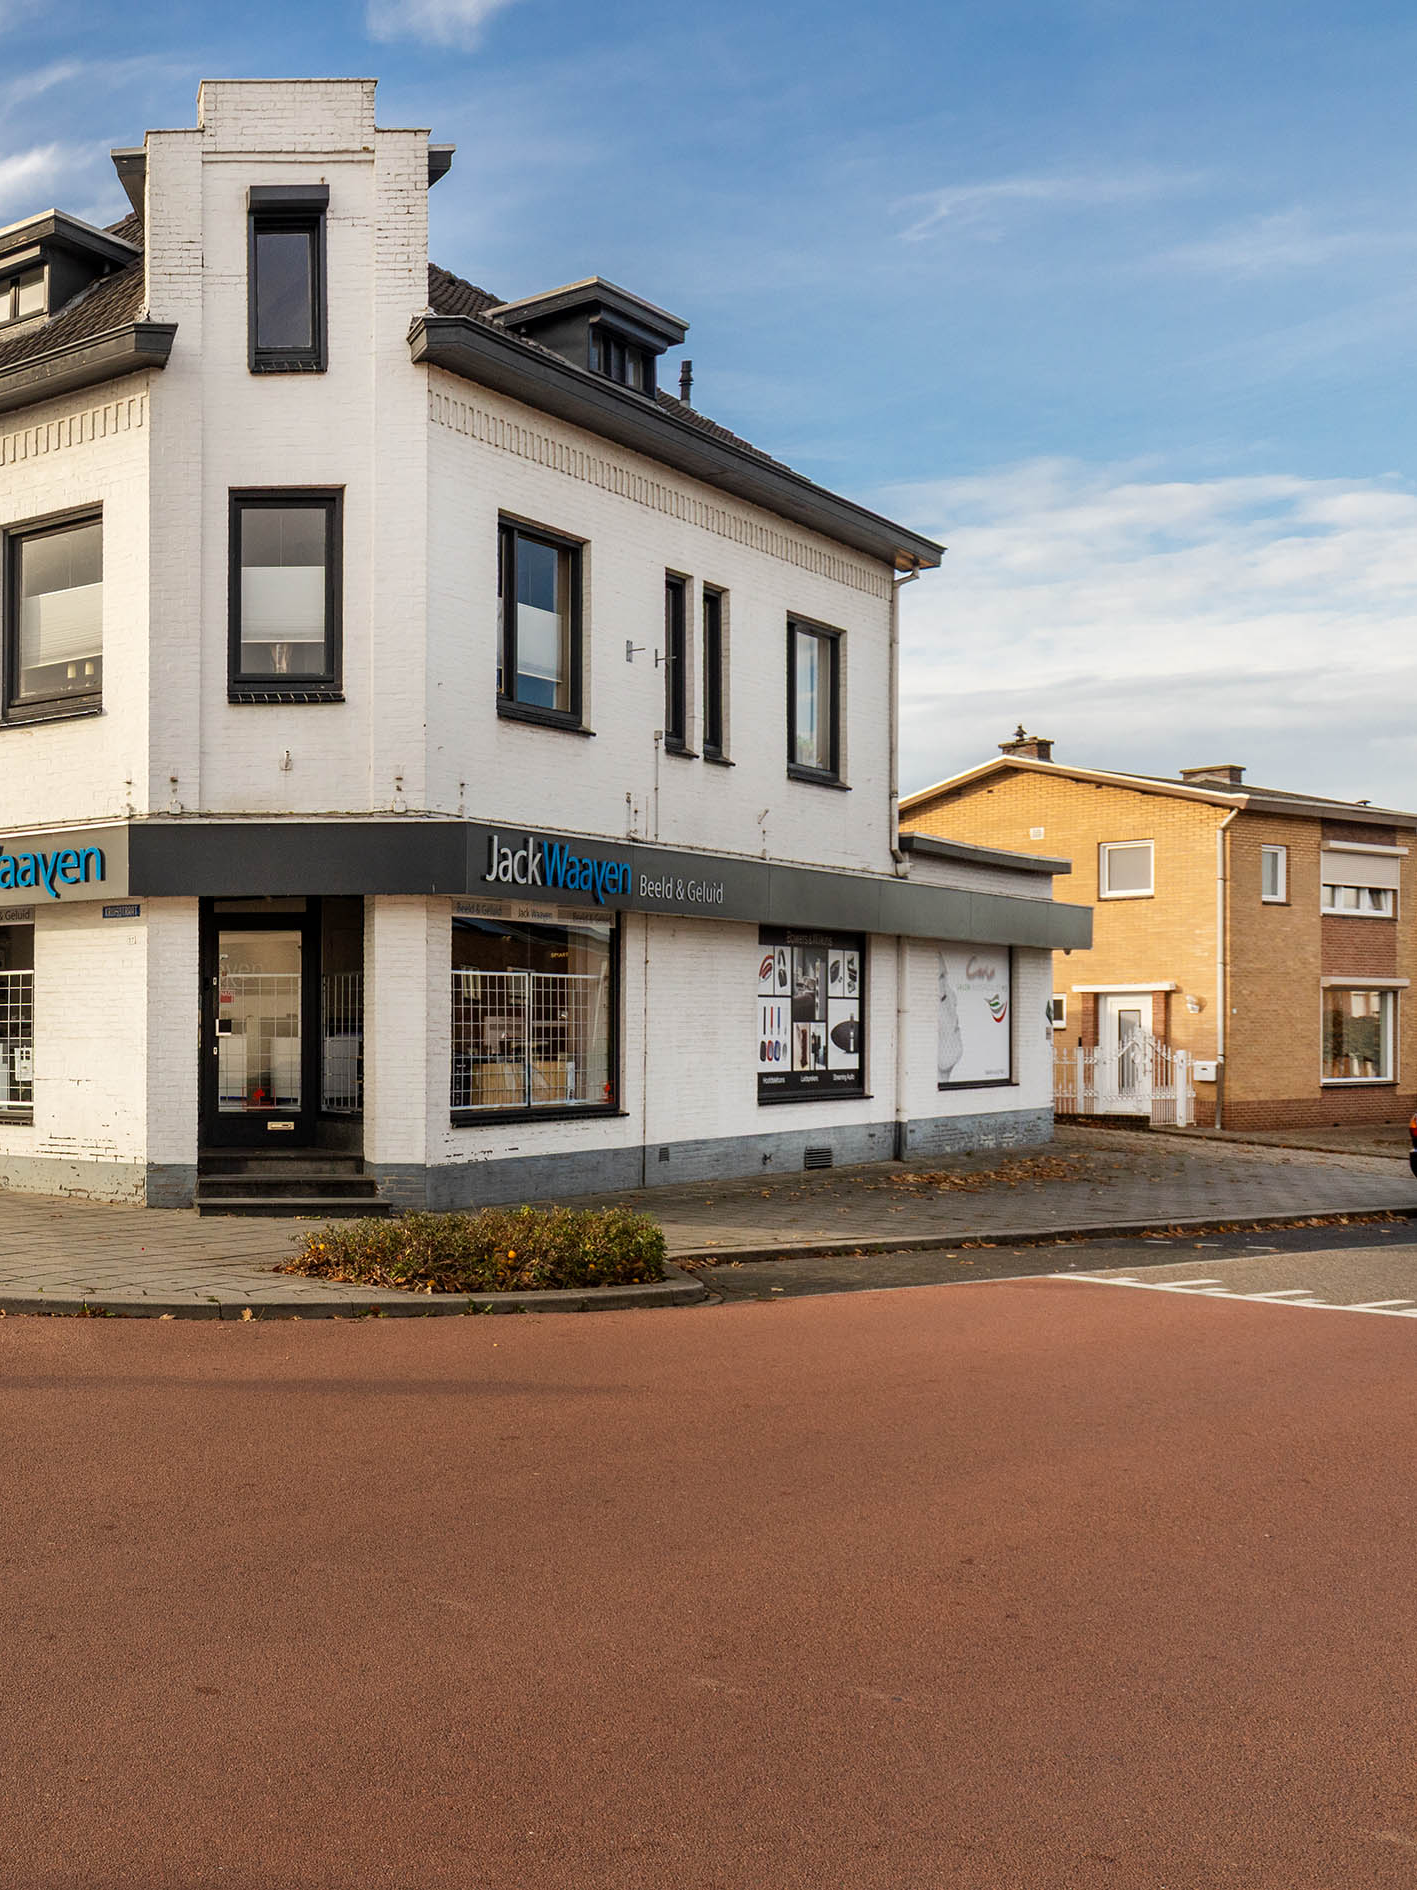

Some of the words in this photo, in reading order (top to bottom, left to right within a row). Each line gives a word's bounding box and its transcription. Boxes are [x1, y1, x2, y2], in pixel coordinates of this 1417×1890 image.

[485, 835, 542, 886] Jack
[542, 840, 631, 905] Waayen
[640, 875, 673, 899] Beeld
[675, 879, 684, 899] &
[687, 880, 724, 904] Geluid
[6, 910, 30, 921] Geluid
